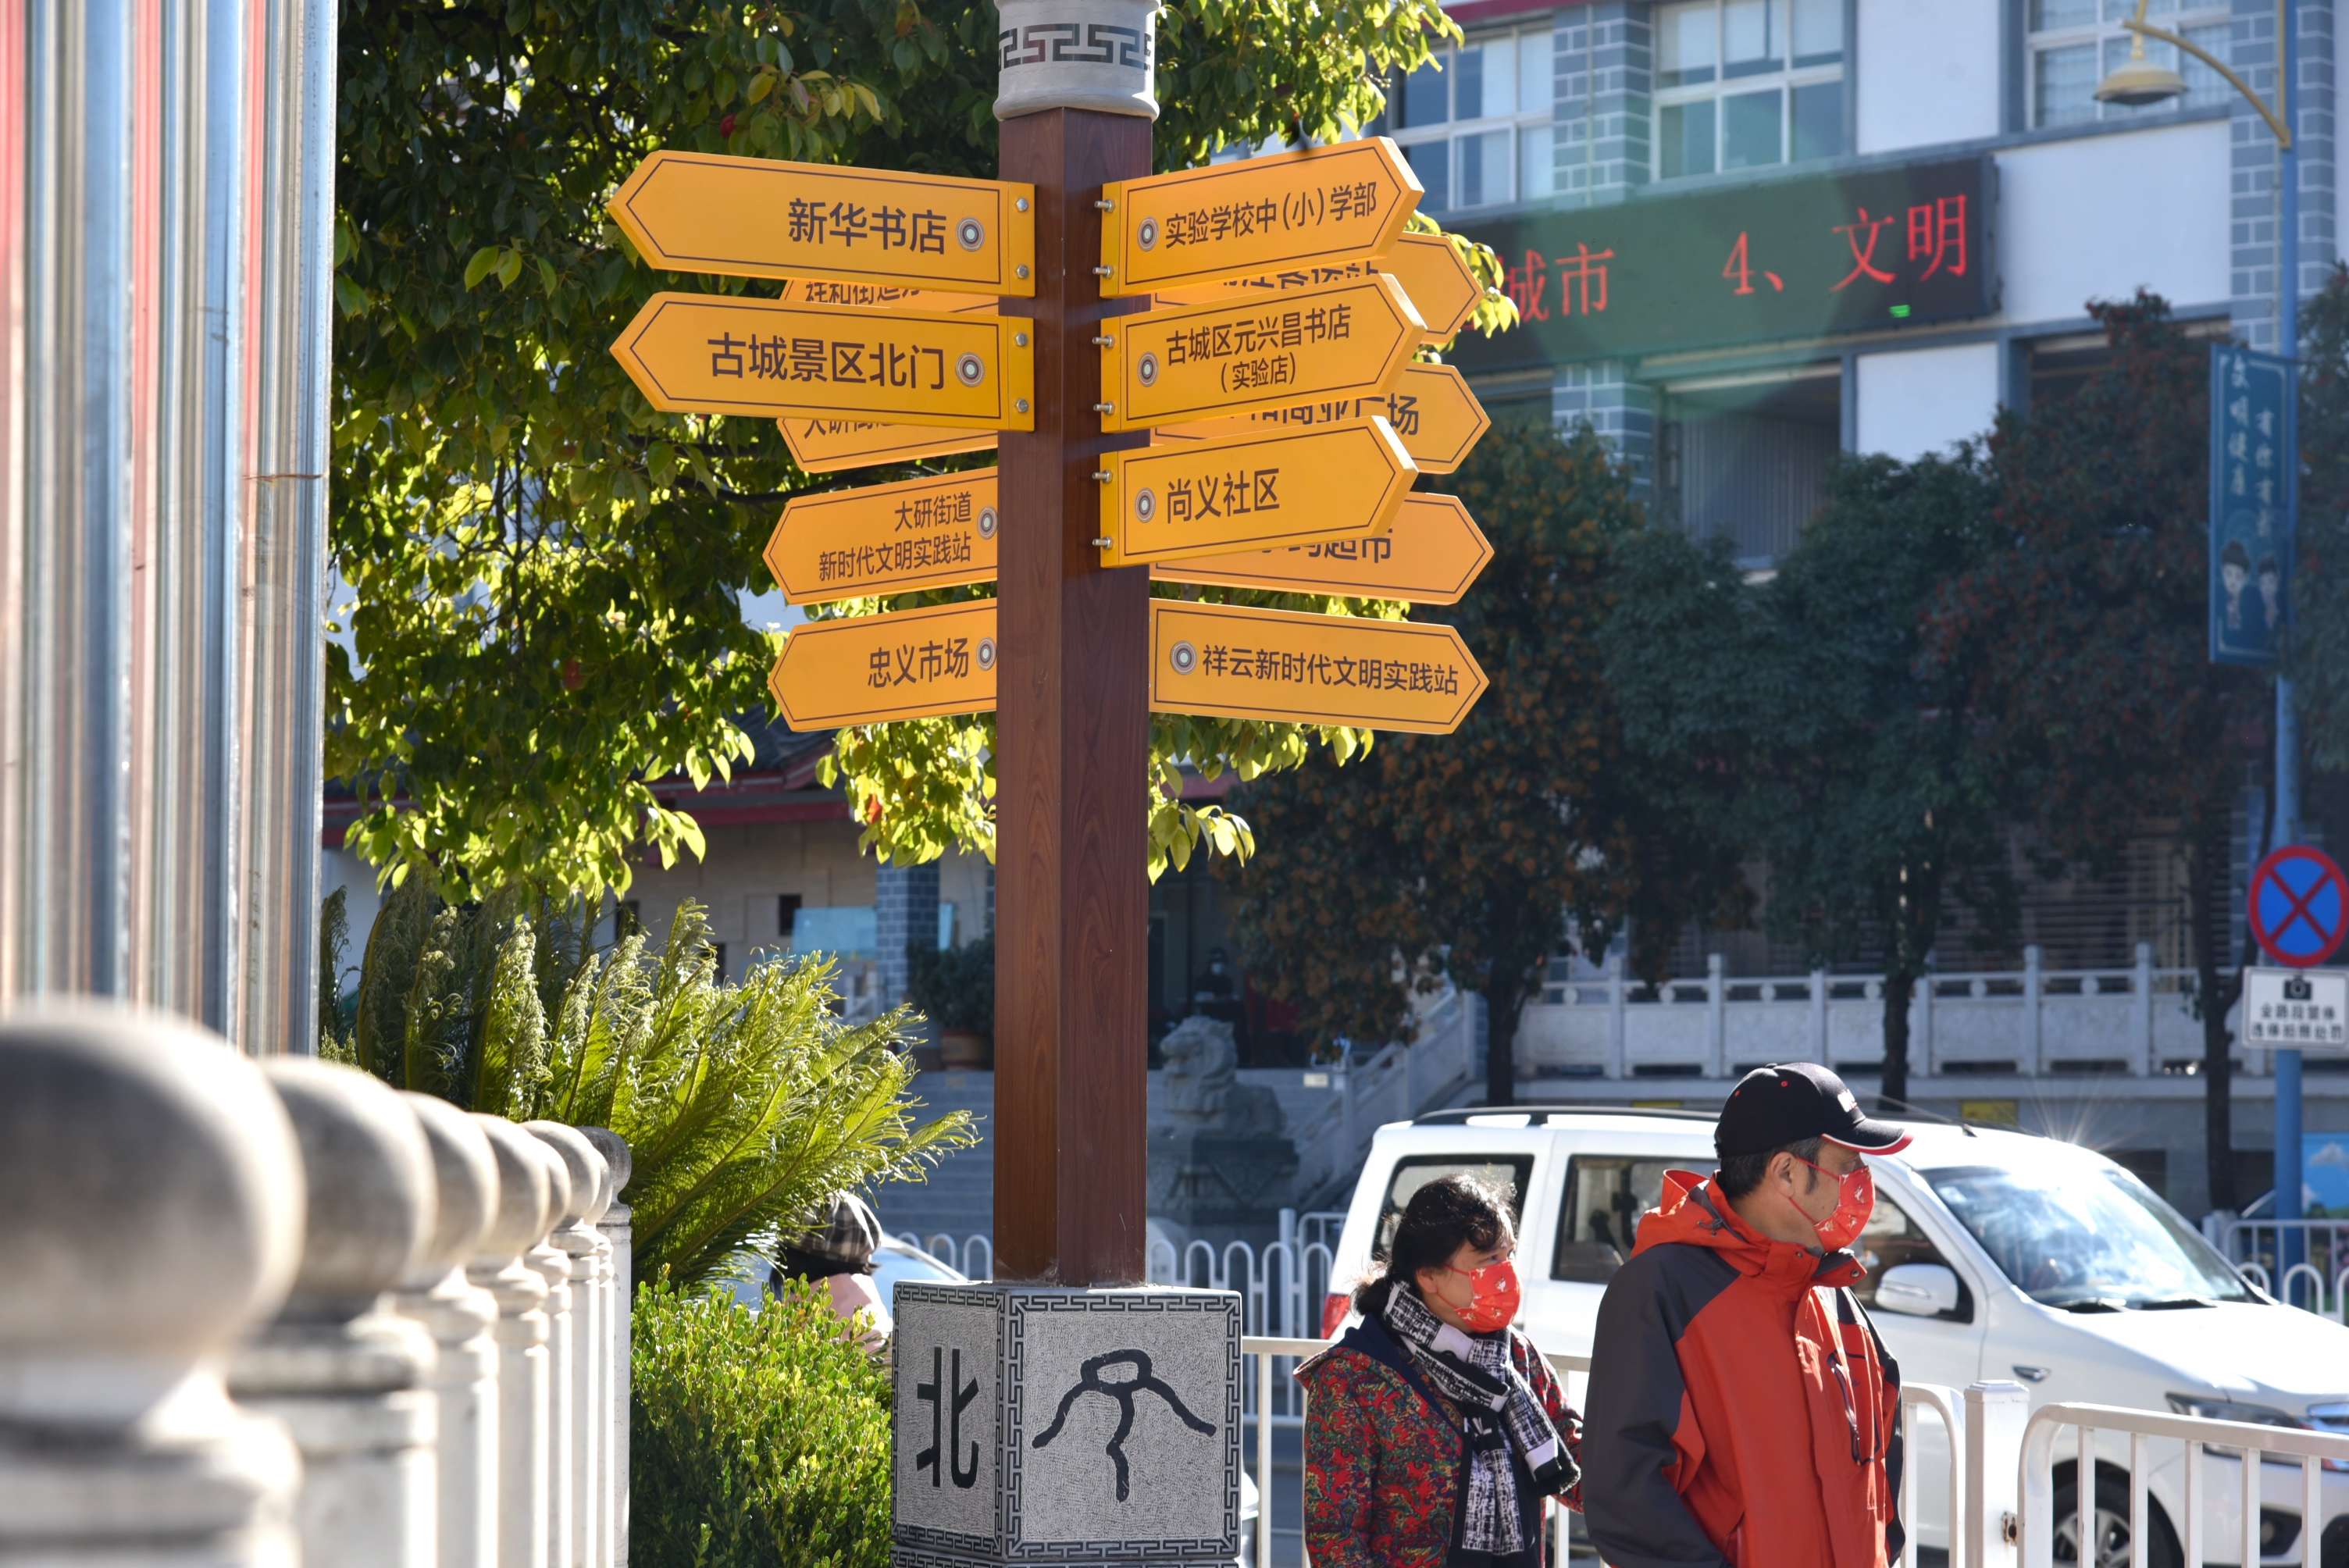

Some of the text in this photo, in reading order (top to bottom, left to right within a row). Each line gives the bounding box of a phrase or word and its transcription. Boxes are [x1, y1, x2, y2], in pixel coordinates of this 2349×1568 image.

[788, 198, 946, 255] 新华书店
[1164, 180, 1378, 249] 实验学校中(小)学部
[1463, 242, 1616, 331] 城市
[708, 332, 944, 390] 古城景区北门
[1165, 303, 1351, 366] 古城区元兴昌书店
[1220, 351, 1296, 393] (实验店)
[894, 490, 972, 533] 大研街道
[1167, 468, 1280, 524] 尚义社区
[818, 531, 971, 582] 新时代文明实践站
[868, 637, 969, 689] 忠义市场
[1203, 643, 1459, 696] 祥云新时代文明实践站
[916, 1346, 979, 1489] 北
